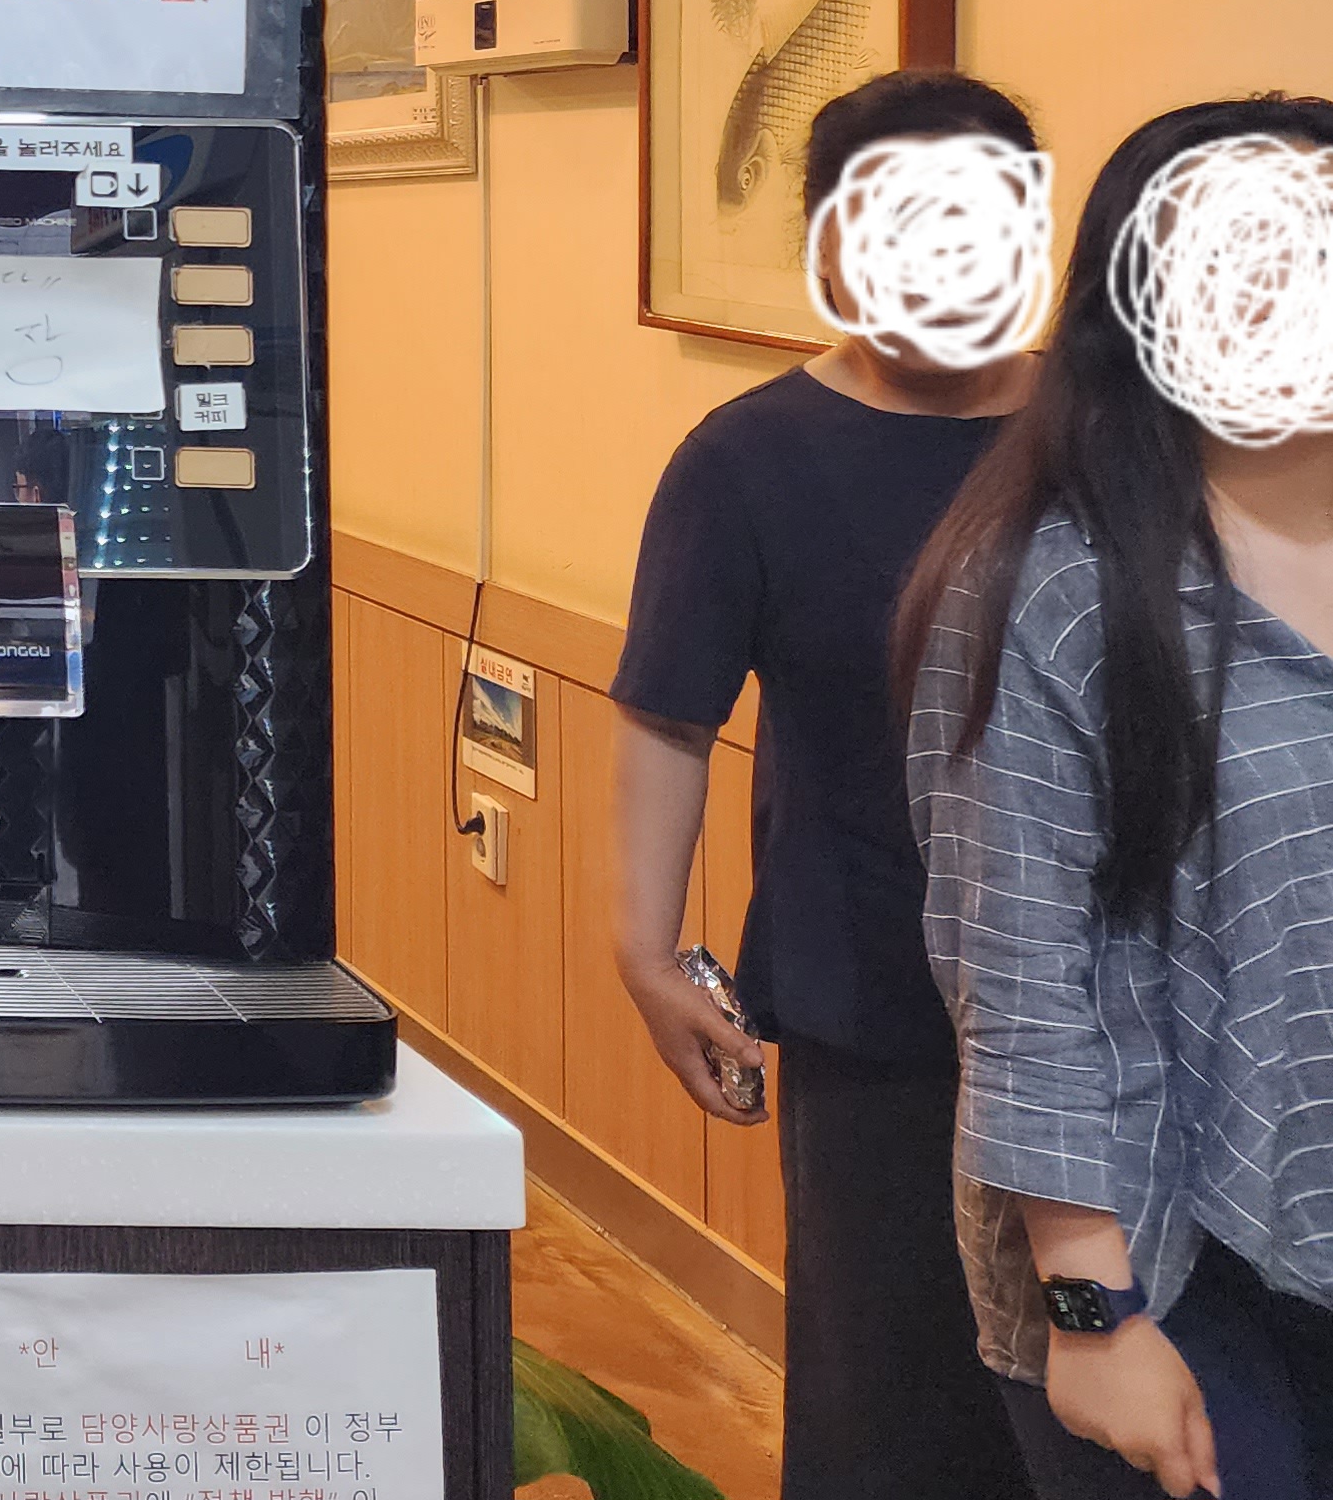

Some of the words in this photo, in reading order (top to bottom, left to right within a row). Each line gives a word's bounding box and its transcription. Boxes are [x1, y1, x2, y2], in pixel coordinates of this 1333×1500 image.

[18, 138, 125, 158] 눌러주세요
[196, 392, 229, 408] 밀크
[194, 410, 227, 424] 커피
[480, 657, 513, 686] 실내금연
[81, 1413, 291, 1444] 담양사랑상품권
[305, 1413, 331, 1443] 이
[344, 1411, 403, 1443] 정부
[42, 1452, 100, 1484] 따라
[113, 1451, 200, 1484] 사용이
[214, 1450, 371, 1482] 제한됩니다.
